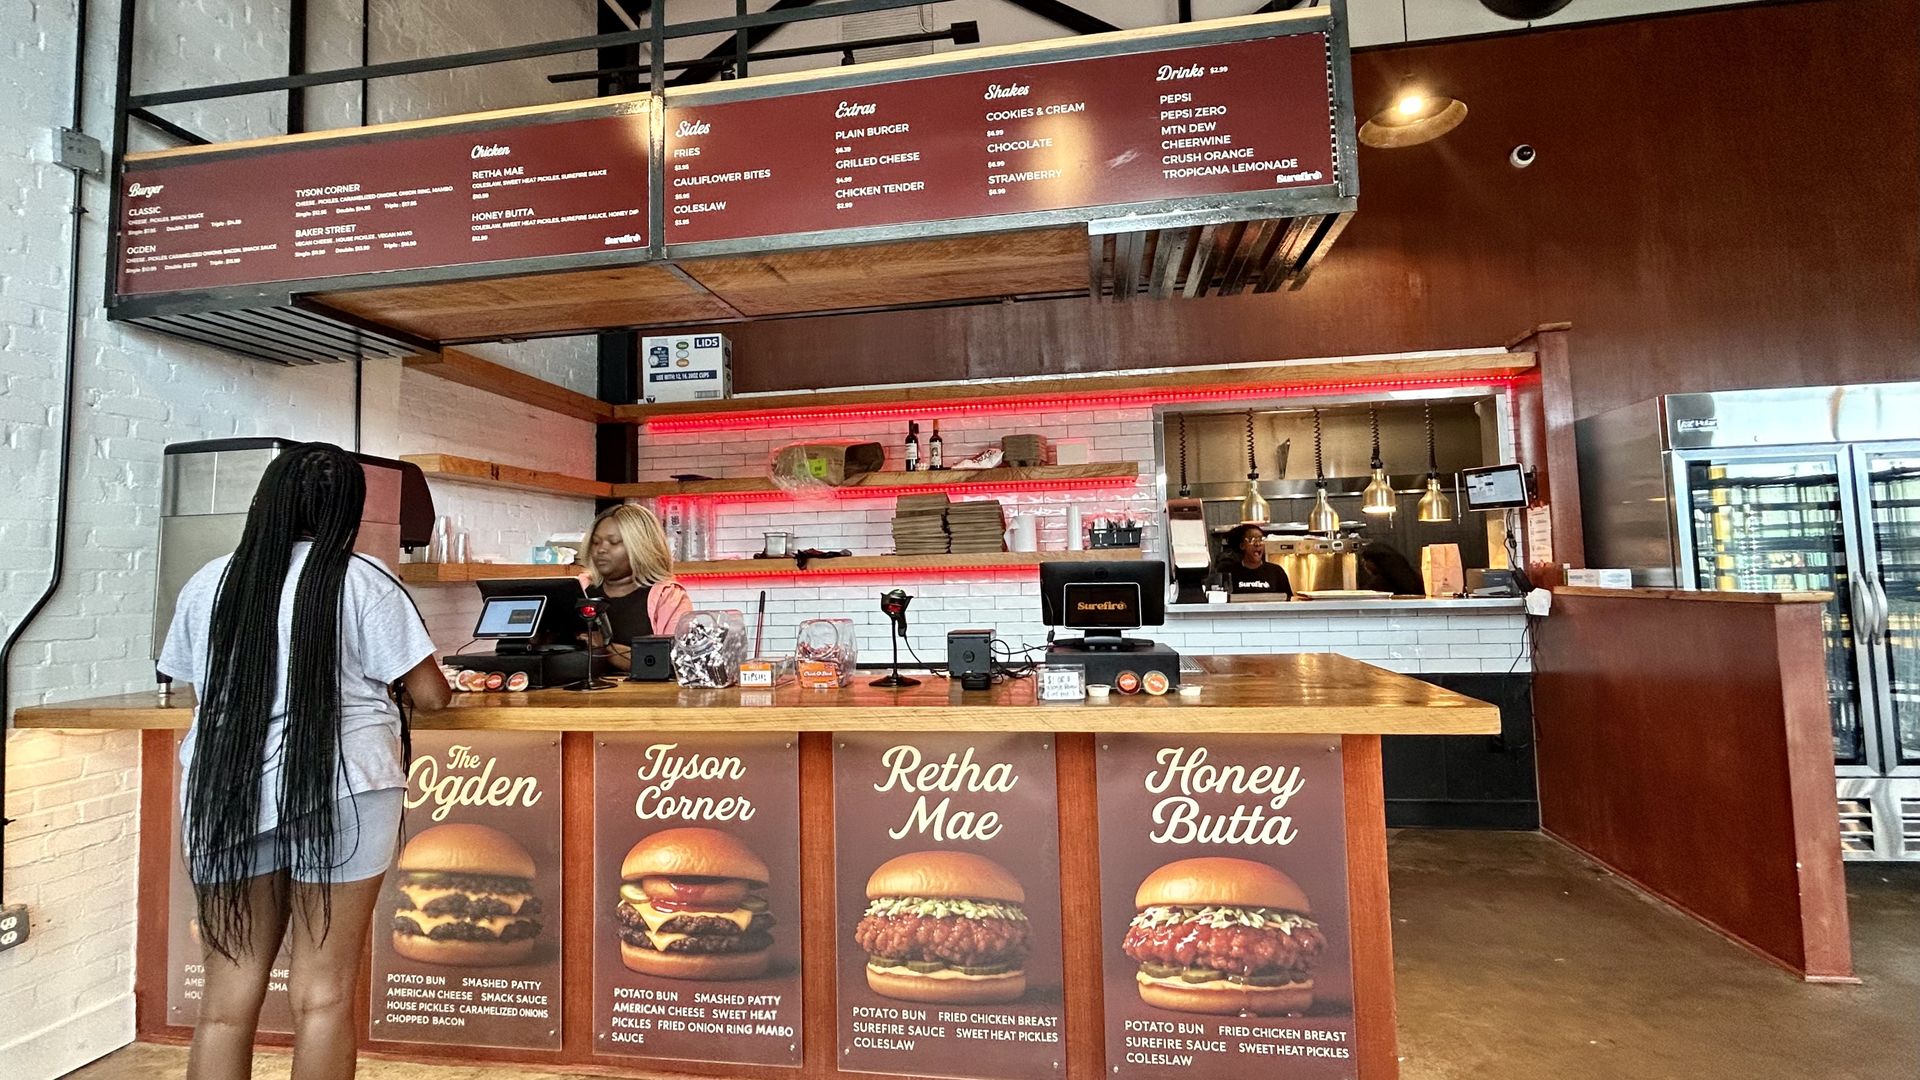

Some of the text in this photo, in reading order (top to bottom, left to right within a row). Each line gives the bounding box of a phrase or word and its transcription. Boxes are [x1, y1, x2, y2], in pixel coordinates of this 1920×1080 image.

[1156, 64, 1204, 81] Drinks
[984, 83, 1029, 100] Shakes
[1160, 93, 1191, 104] PEPSI
[835, 102, 876, 118] Extras
[986, 103, 1084, 121] COOKIES & CREAM
[1161, 106, 1226, 120] PEPSI ZERO
[676, 120, 710, 138] Sides
[836, 124, 909, 139] PLAIN BURGER
[1162, 122, 1216, 135] MTN DEW
[987, 138, 1053, 152] CHOCOLATE
[1162, 135, 1230, 149] CHEERWINE
[471, 144, 510, 159] Chicken
[674, 147, 700, 157] FRIES
[1162, 148, 1254, 164] CRUSH ORANGE
[836, 152, 920, 169] GRILLED CHEESE
[472, 167, 523, 179] RETHA MAE
[989, 168, 1062, 184] STRAWBERRY
[1163, 159, 1298, 179] TROPICANA LEMONADE
[674, 169, 770, 186] CAULIFLOWER BITES
[128, 183, 164, 198] Burger
[296, 184, 360, 197] TYSON CORNER
[835, 182, 924, 198] CHICKEN TENDER
[129, 206, 161, 216] CLASSIC
[472, 208, 534, 221] HONEY BUTTA
[674, 202, 726, 214] COLESLAW
[296, 224, 356, 237] BAKER STREET
[127, 245, 156, 254] OGDEN
[697, 338, 718, 347] LIDS
[1078, 601, 1124, 610] Surefire
[447, 745, 480, 769] The
[638, 744, 746, 795] Tyson
[874, 746, 1018, 792] Retha
[1145, 747, 1305, 808] Honey
[404, 755, 542, 822] Ogden
[636, 786, 755, 820] Corner
[889, 796, 1002, 841] Mae
[1150, 796, 1298, 845] Butta
[388, 974, 541, 990] POTATO BUN SMASHED PATTY
[387, 988, 547, 1004] AMERICAN CHEESE SMACK SAUCE
[614, 988, 780, 1005] POTATO BUN SMASHED PATTY
[387, 1001, 548, 1018] HOUSE PICKLES CARAMELIZED ONIONS
[613, 1002, 777, 1020] AMERICAN CHEESE SWEET HEAT
[853, 1007, 1057, 1026] POTATO BUN FRIED CHICKEN BREAST
[387, 1014, 464, 1026] CHOPPED BACON
[612, 1017, 651, 1029] PICKLES
[658, 1020, 685, 1030] FRIED
[688, 1022, 723, 1033] ONION
[727, 1024, 752, 1034] RING
[612, 1032, 644, 1043] SAUCE
[854, 1022, 1058, 1042] SUREFIRE SAUCE SWEET HEAT PICKLES
[1125, 1020, 1346, 1041] POTATO BUN FRIED CHICKEN BREAST
[854, 1037, 914, 1050] COLESLAW
[1126, 1037, 1349, 1058] SUREFIRE SAUCE SWEET HEAT PICKLES
[1126, 1053, 1192, 1066] COLESLAW
